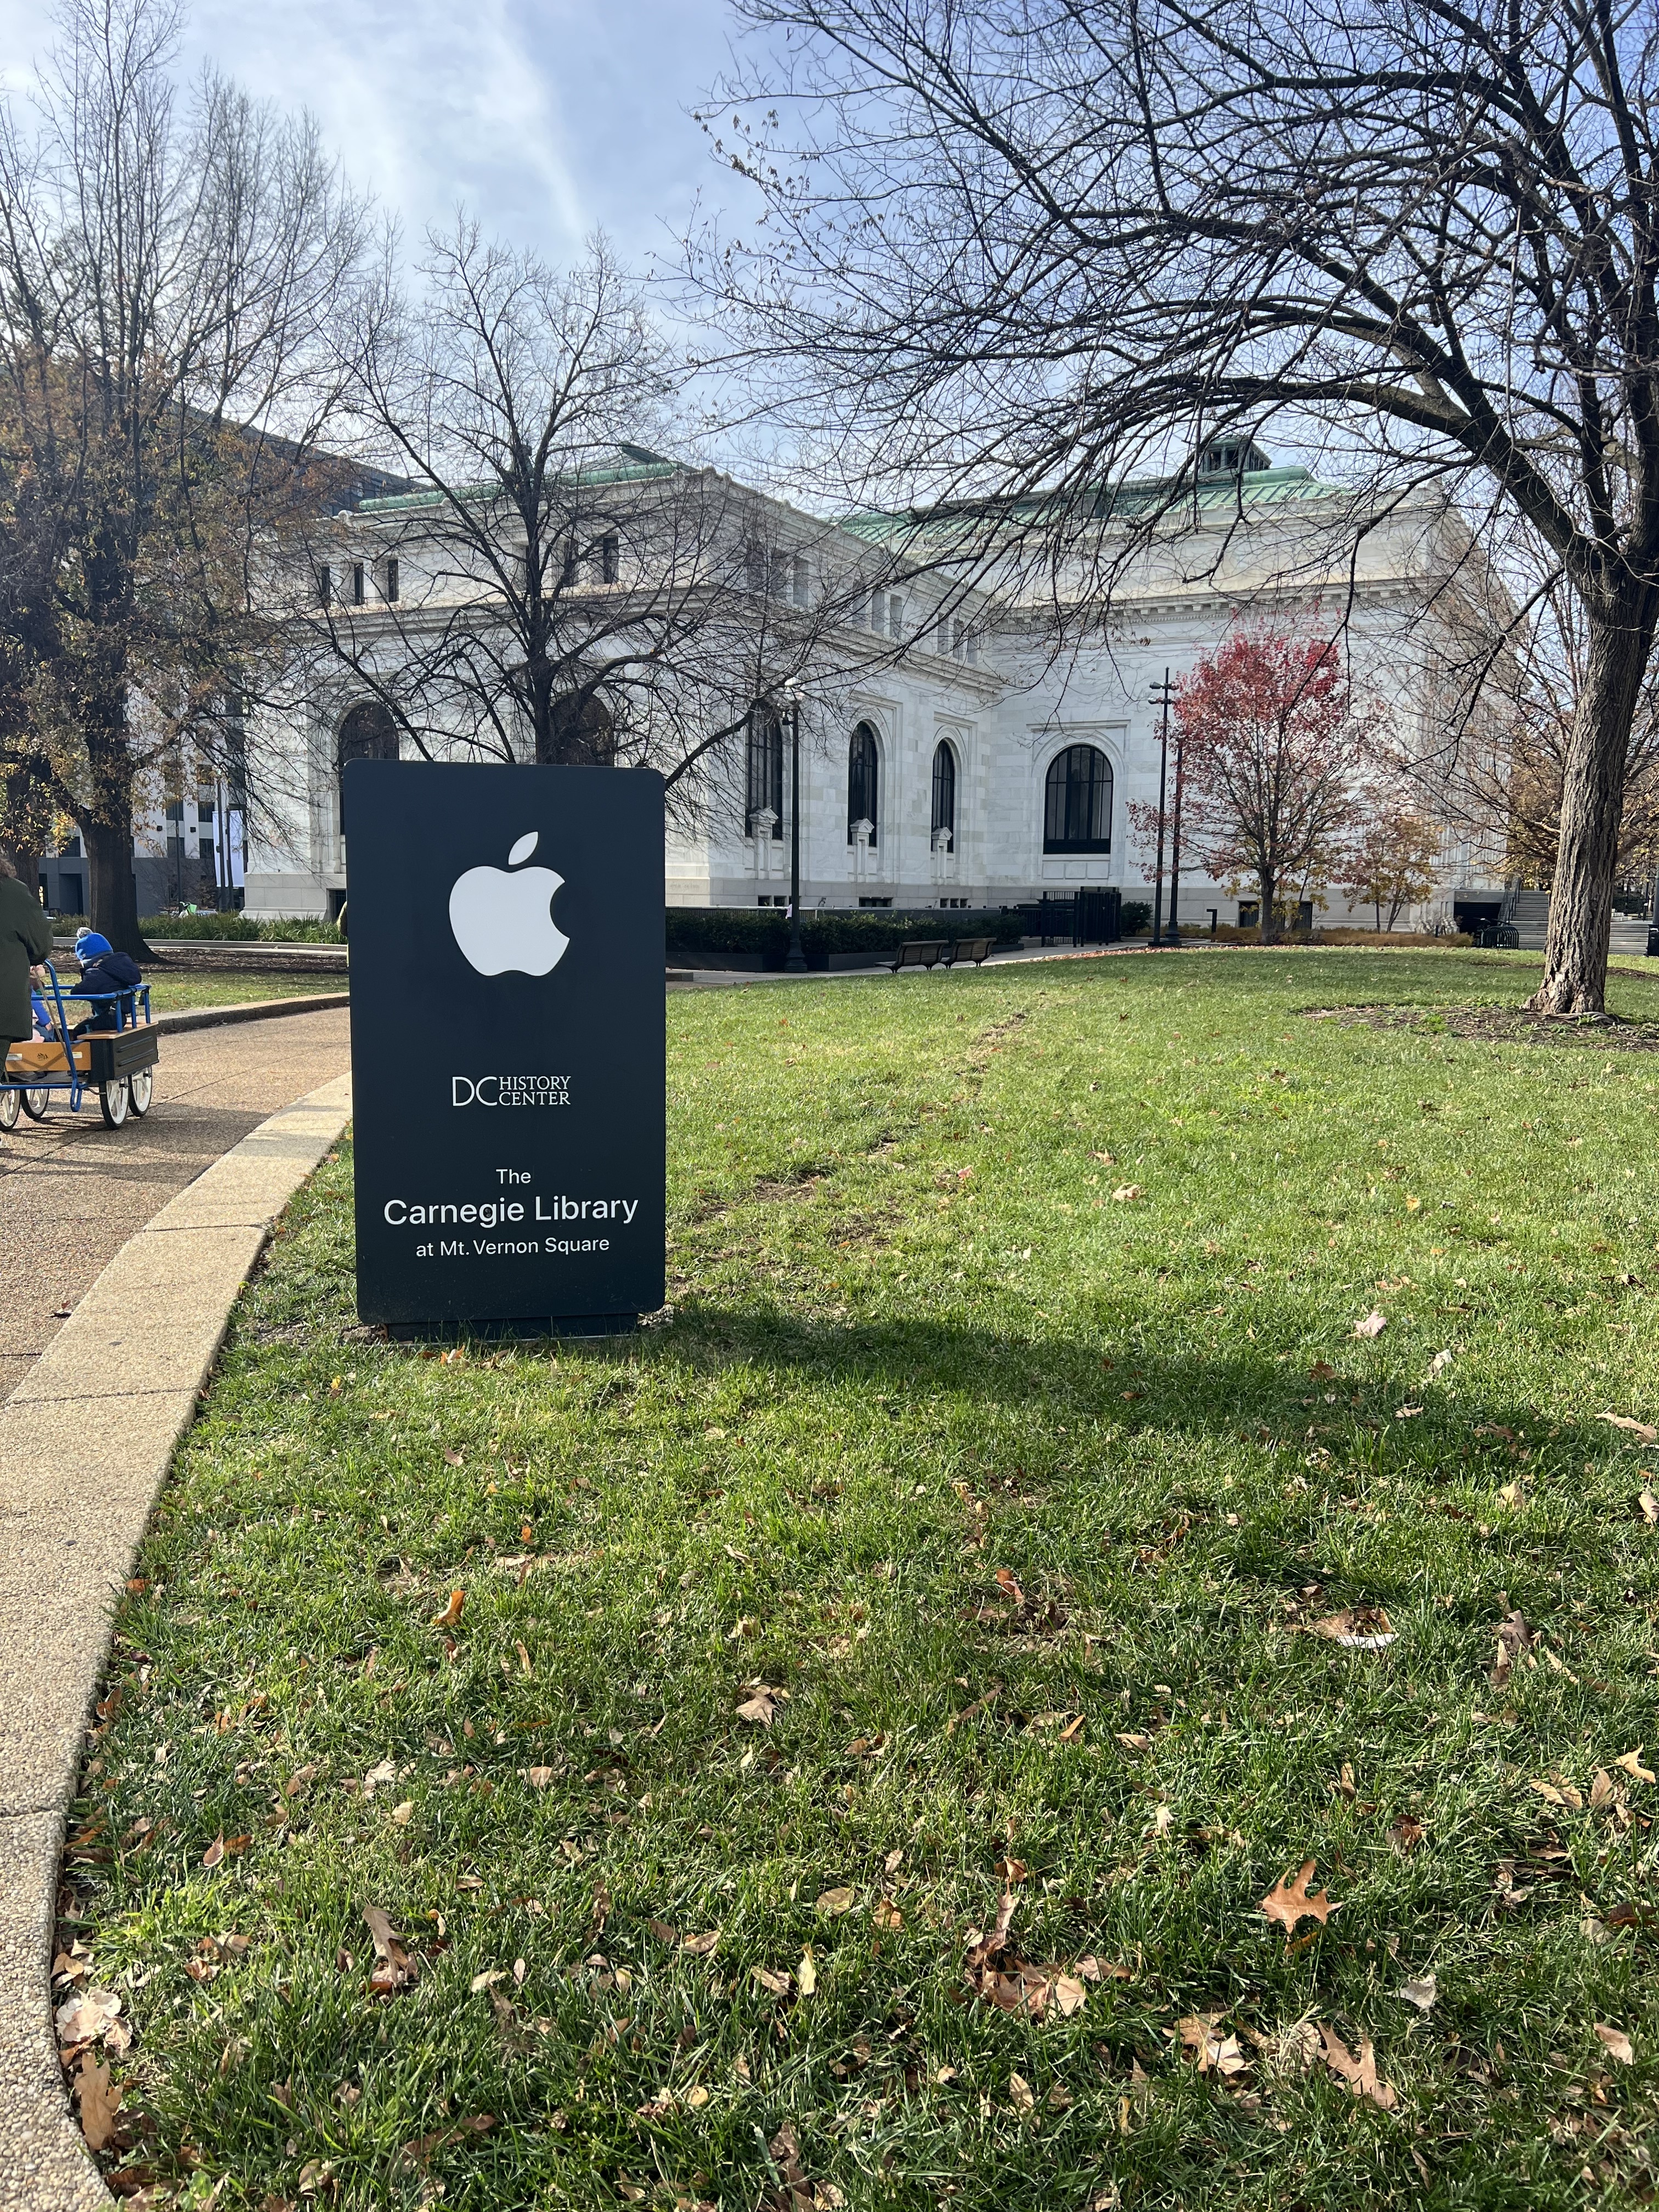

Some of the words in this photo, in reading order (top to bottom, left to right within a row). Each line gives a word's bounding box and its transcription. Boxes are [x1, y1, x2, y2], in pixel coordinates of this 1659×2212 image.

[452, 1076, 498, 1107] DC
[499, 1076, 571, 1090] HISTORY
[499, 1091, 571, 1106] CENTER
[495, 1169, 532, 1184] The
[384, 1197, 524, 1228] Carnegie
[535, 1195, 639, 1224] Library
[416, 1241, 434, 1257] at
[441, 1240, 470, 1256] Mt.
[473, 1239, 539, 1255] Vernon
[545, 1237, 610, 1255] Square
